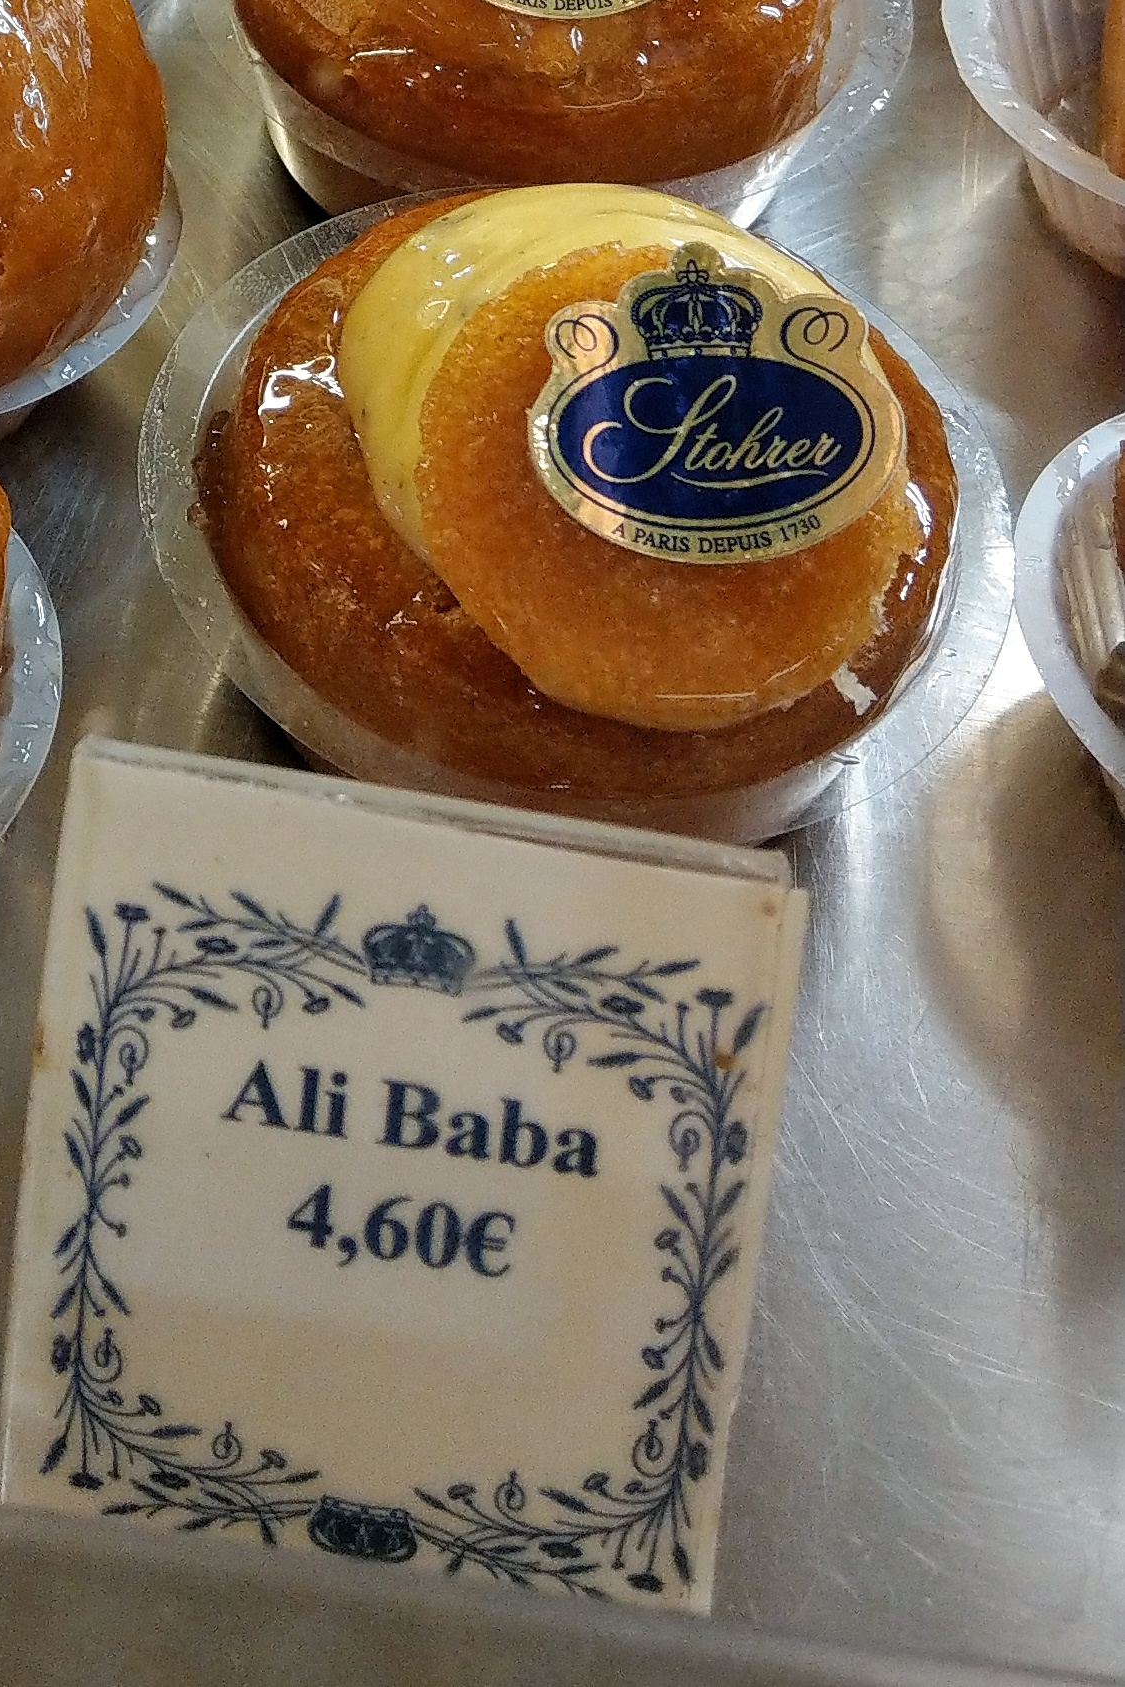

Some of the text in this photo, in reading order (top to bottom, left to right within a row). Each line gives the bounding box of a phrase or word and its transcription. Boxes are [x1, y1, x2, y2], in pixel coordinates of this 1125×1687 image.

[583, 374, 842, 486] Stohrer
[633, 526, 690, 554] PARIS
[698, 531, 773, 555] DEPUIS
[779, 514, 822, 543] 1730
[220, 1059, 600, 1179] Ali Baba
[286, 1184, 517, 1279] 4,60€
